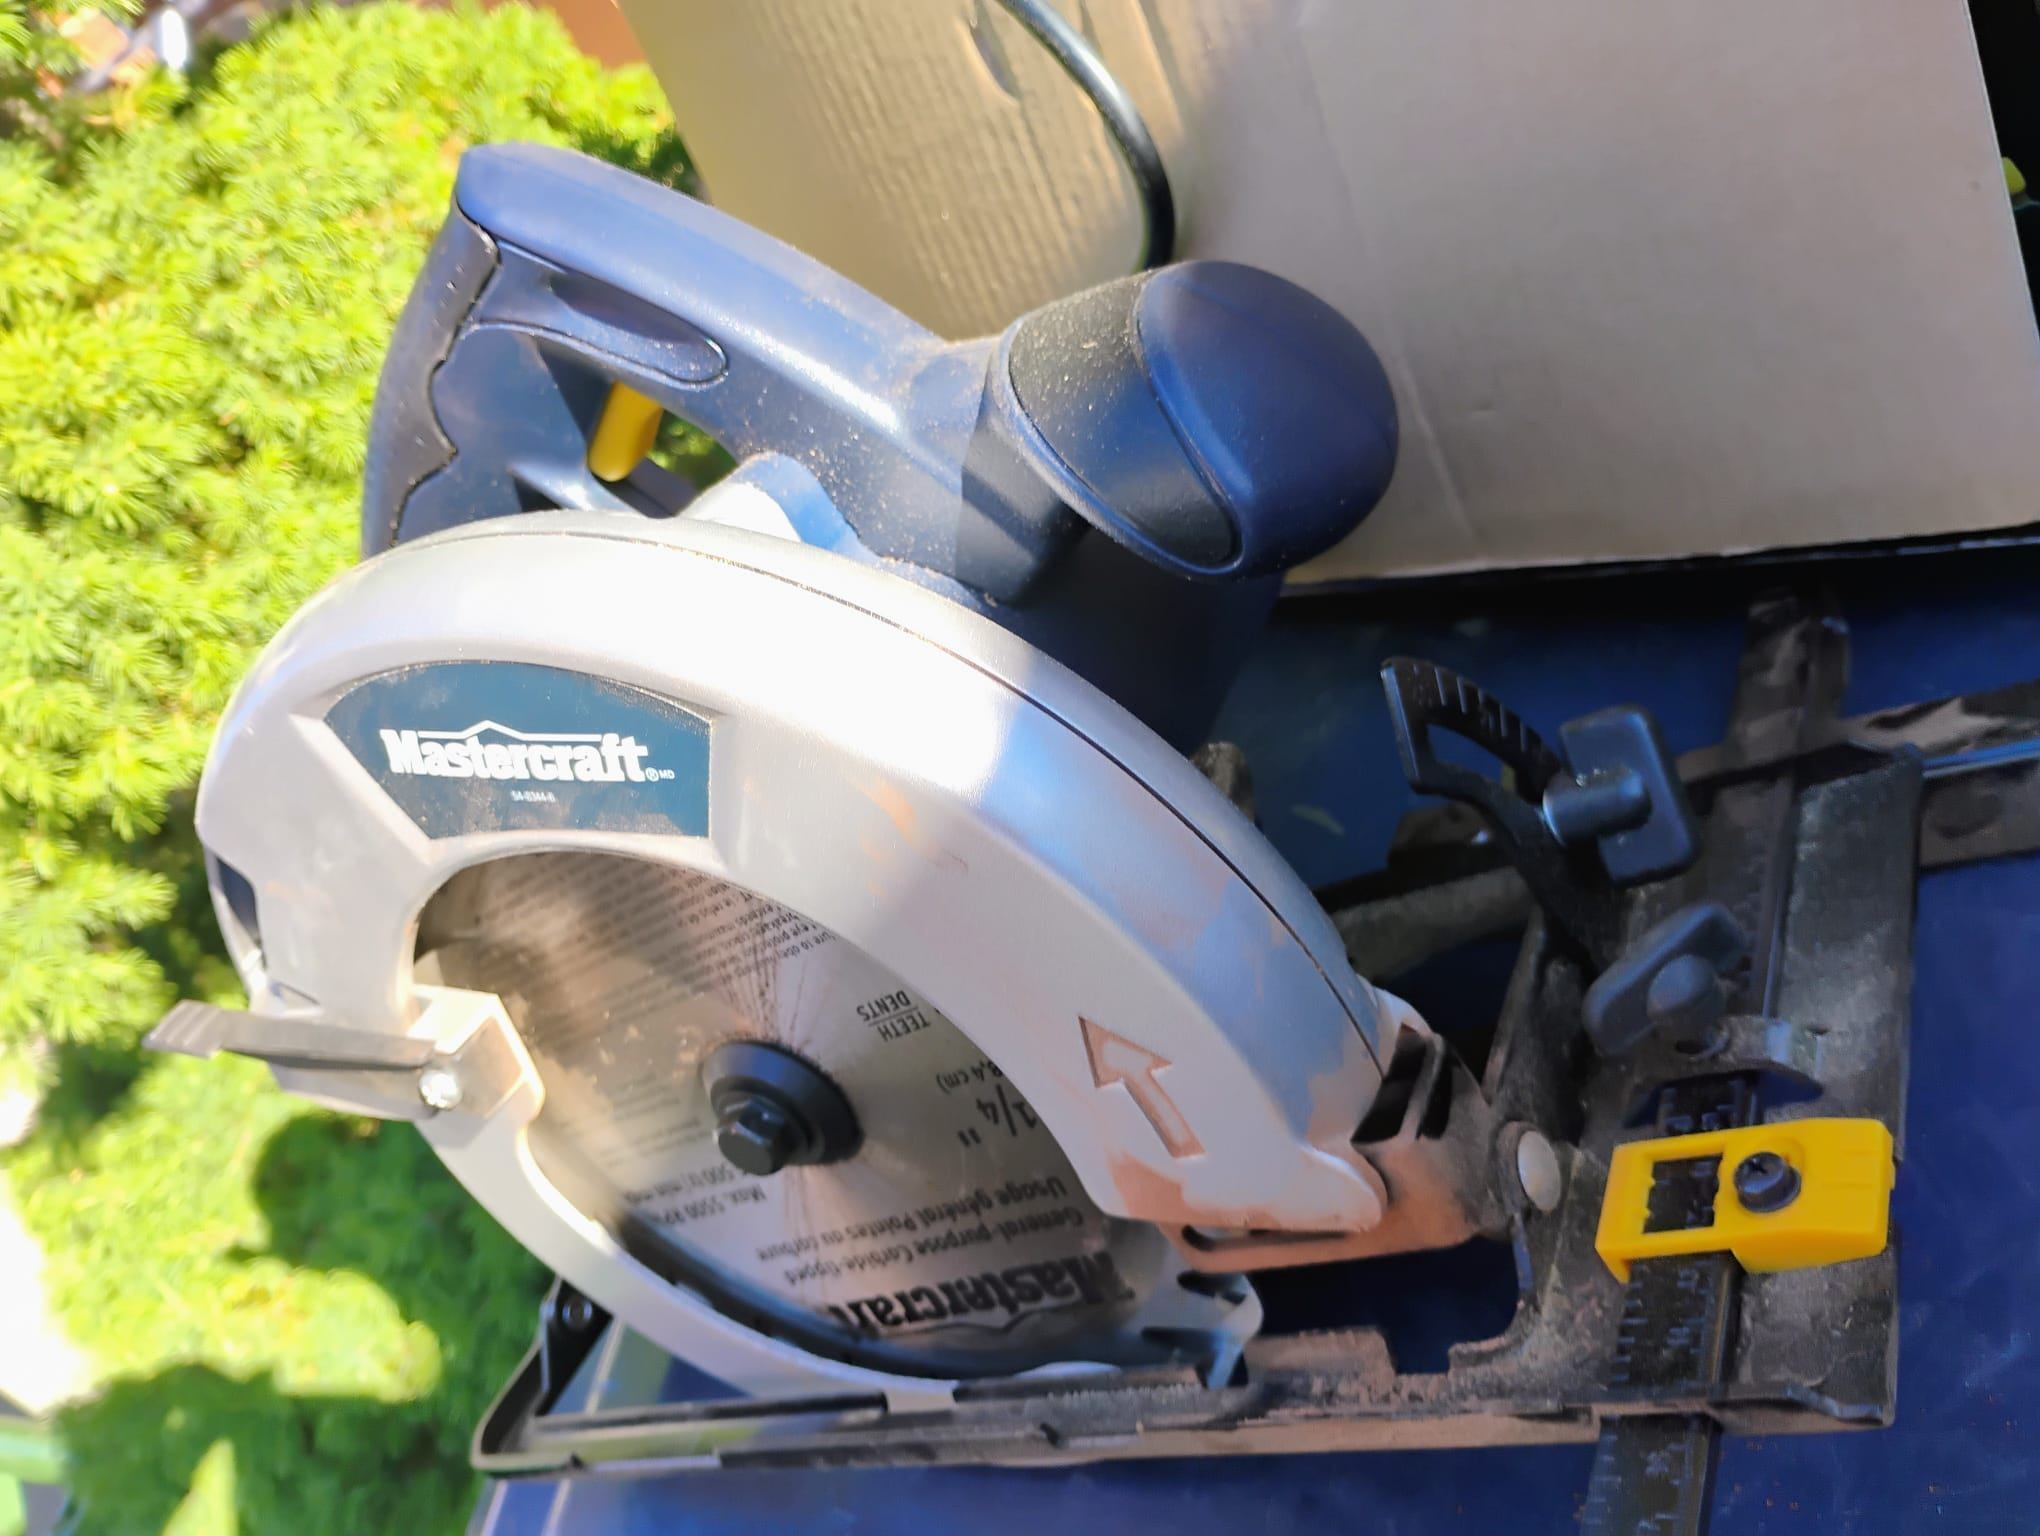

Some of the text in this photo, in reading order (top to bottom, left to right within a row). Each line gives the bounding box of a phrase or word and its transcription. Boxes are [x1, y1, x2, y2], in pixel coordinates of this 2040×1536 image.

[380, 728, 649, 782] Mastercraft
[857, 990, 911, 1022] DENTS
[877, 1012, 931, 1042] TEETH
[936, 1069, 969, 1094] cm)
[995, 1175, 1068, 1207] Usage
[847, 1209, 918, 1241] Pointes
